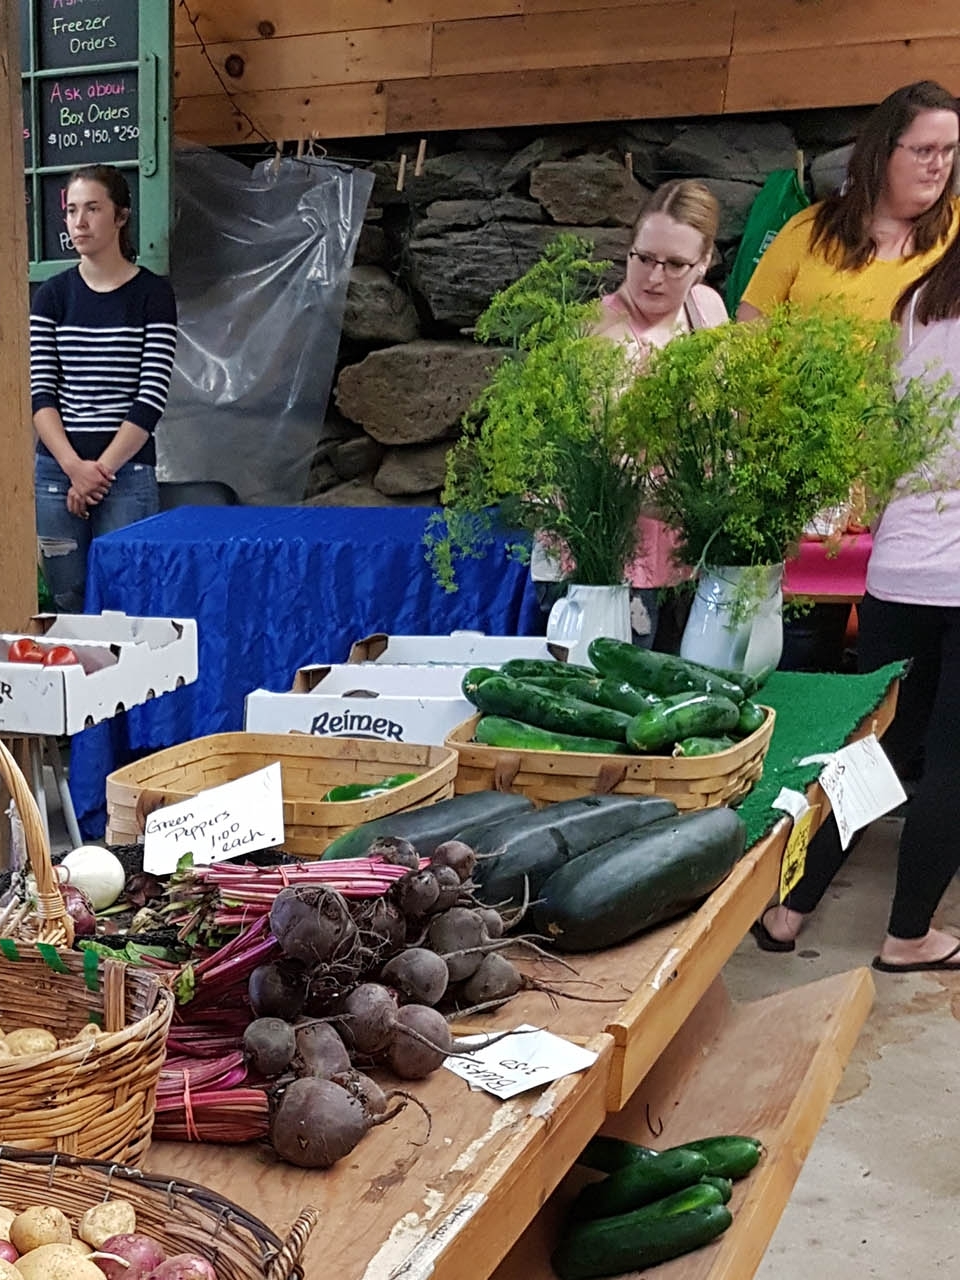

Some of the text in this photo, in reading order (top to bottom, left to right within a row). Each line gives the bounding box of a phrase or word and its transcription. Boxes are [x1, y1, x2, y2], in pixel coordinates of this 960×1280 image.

[52, 15, 111, 36] Freezer
[70, 35, 117, 53] Orders
[50, 82, 83, 104] Ask
[60, 103, 130, 127] Box Orders
[146, 811, 195, 834] Green
[165, 810, 231, 842] Peppers
[222, 829, 265, 853] each
